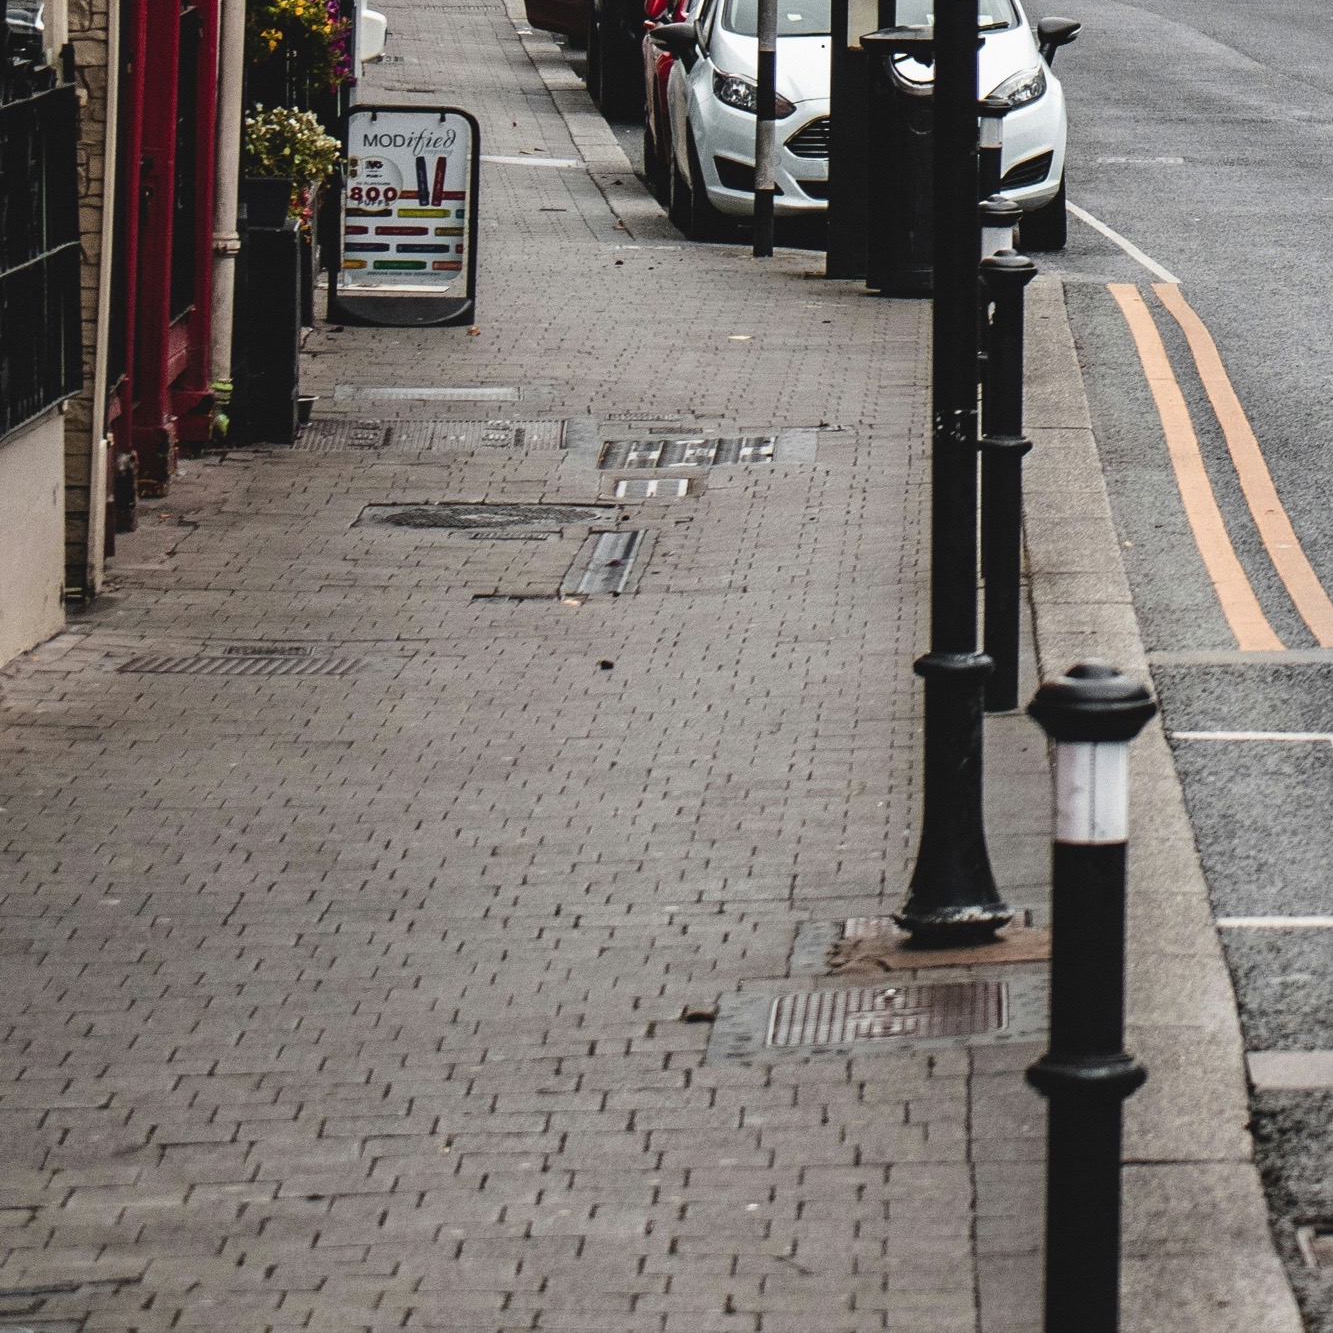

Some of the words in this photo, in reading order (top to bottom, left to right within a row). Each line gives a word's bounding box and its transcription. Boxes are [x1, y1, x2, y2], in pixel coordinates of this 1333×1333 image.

[363, 128, 456, 156] MODified
[350, 186, 398, 202] 800
[357, 199, 390, 207] PUFFS
